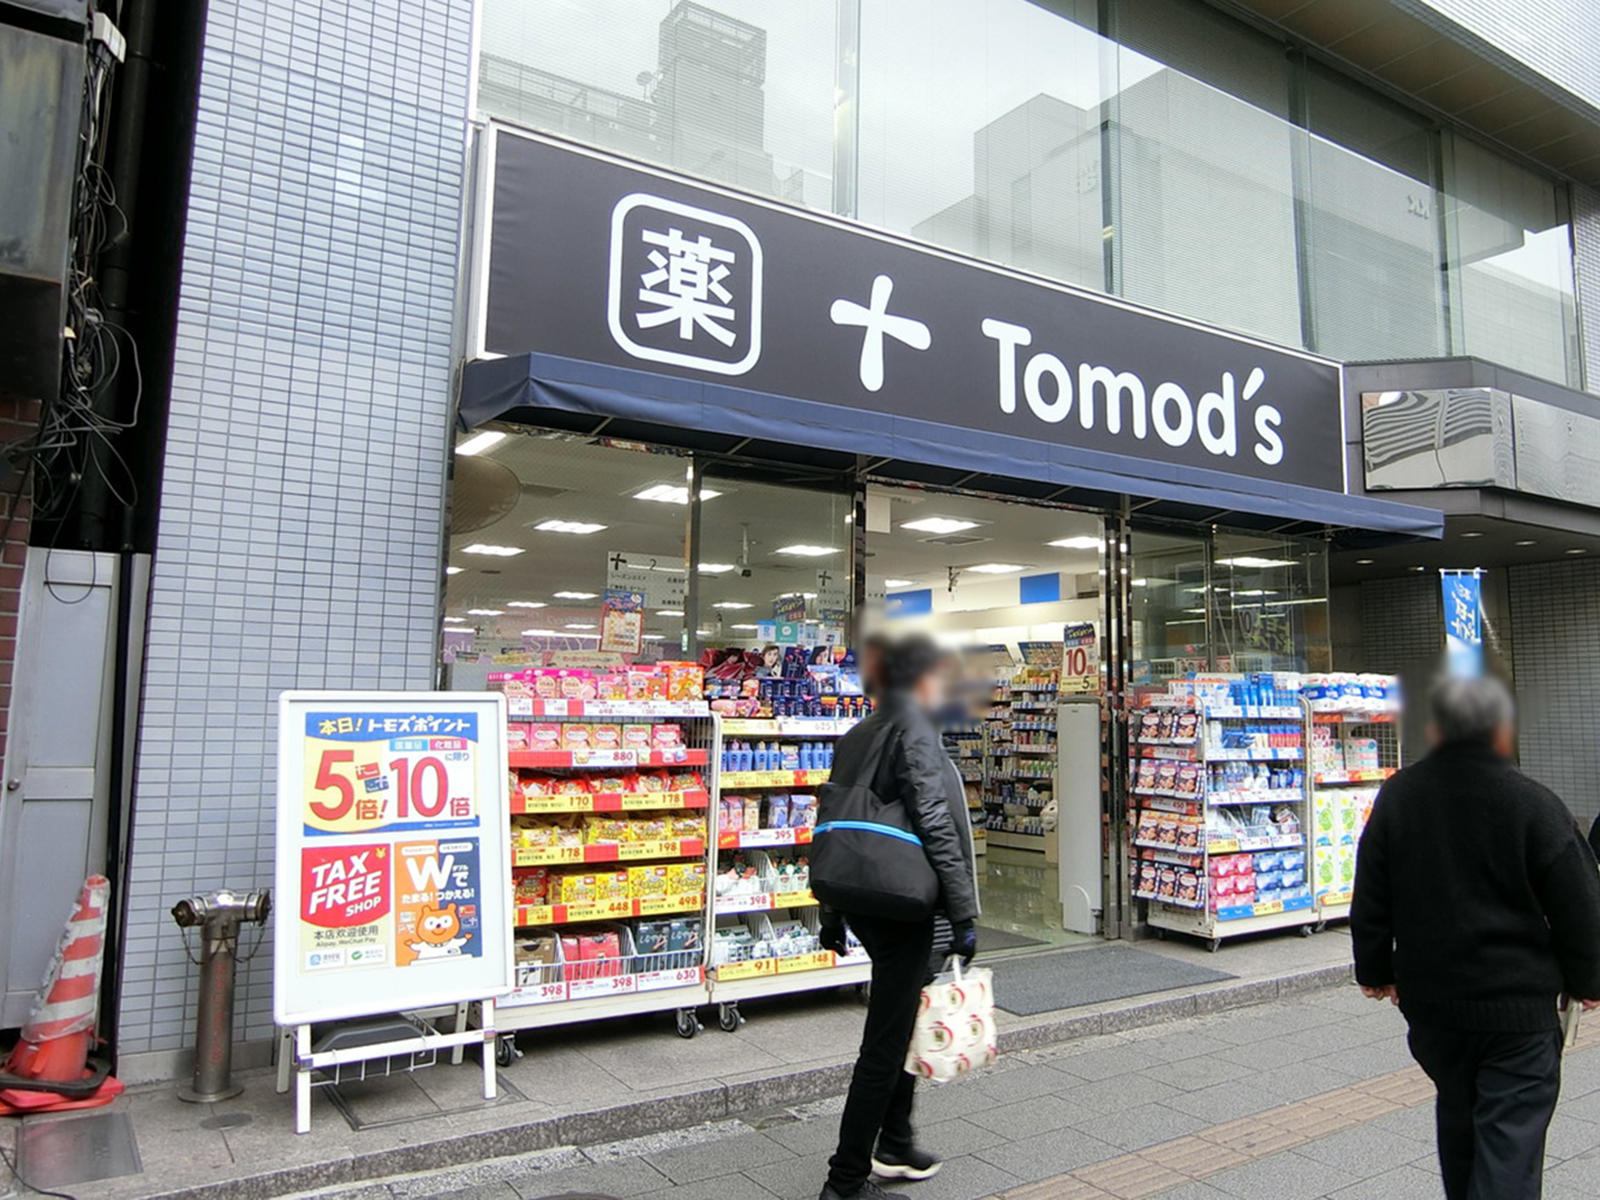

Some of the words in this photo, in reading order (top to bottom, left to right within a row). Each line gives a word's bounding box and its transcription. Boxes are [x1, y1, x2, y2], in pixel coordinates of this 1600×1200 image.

[635, 228, 736, 348] 薬
[981, 318, 1284, 466] Tomod's
[319, 717, 363, 735] 本日!
[368, 715, 470, 732] トモズポイント
[612, 751, 633, 761] 880
[569, 796, 590, 807] 170
[661, 793, 680, 804] 178
[560, 847, 580, 858] 178
[658, 842, 677, 852] 198
[311, 851, 369, 888] TAX
[308, 870, 382, 915] FREE
[678, 896, 698, 906] 498
[750, 895, 767, 905] 398
[345, 896, 382, 918] SHOP
[608, 901, 629, 912] 448
[811, 953, 829, 963] 148
[754, 960, 770, 971] 91
[676, 969, 696, 981] 630
[612, 977, 633, 988] 398
[541, 985, 563, 997] 398
